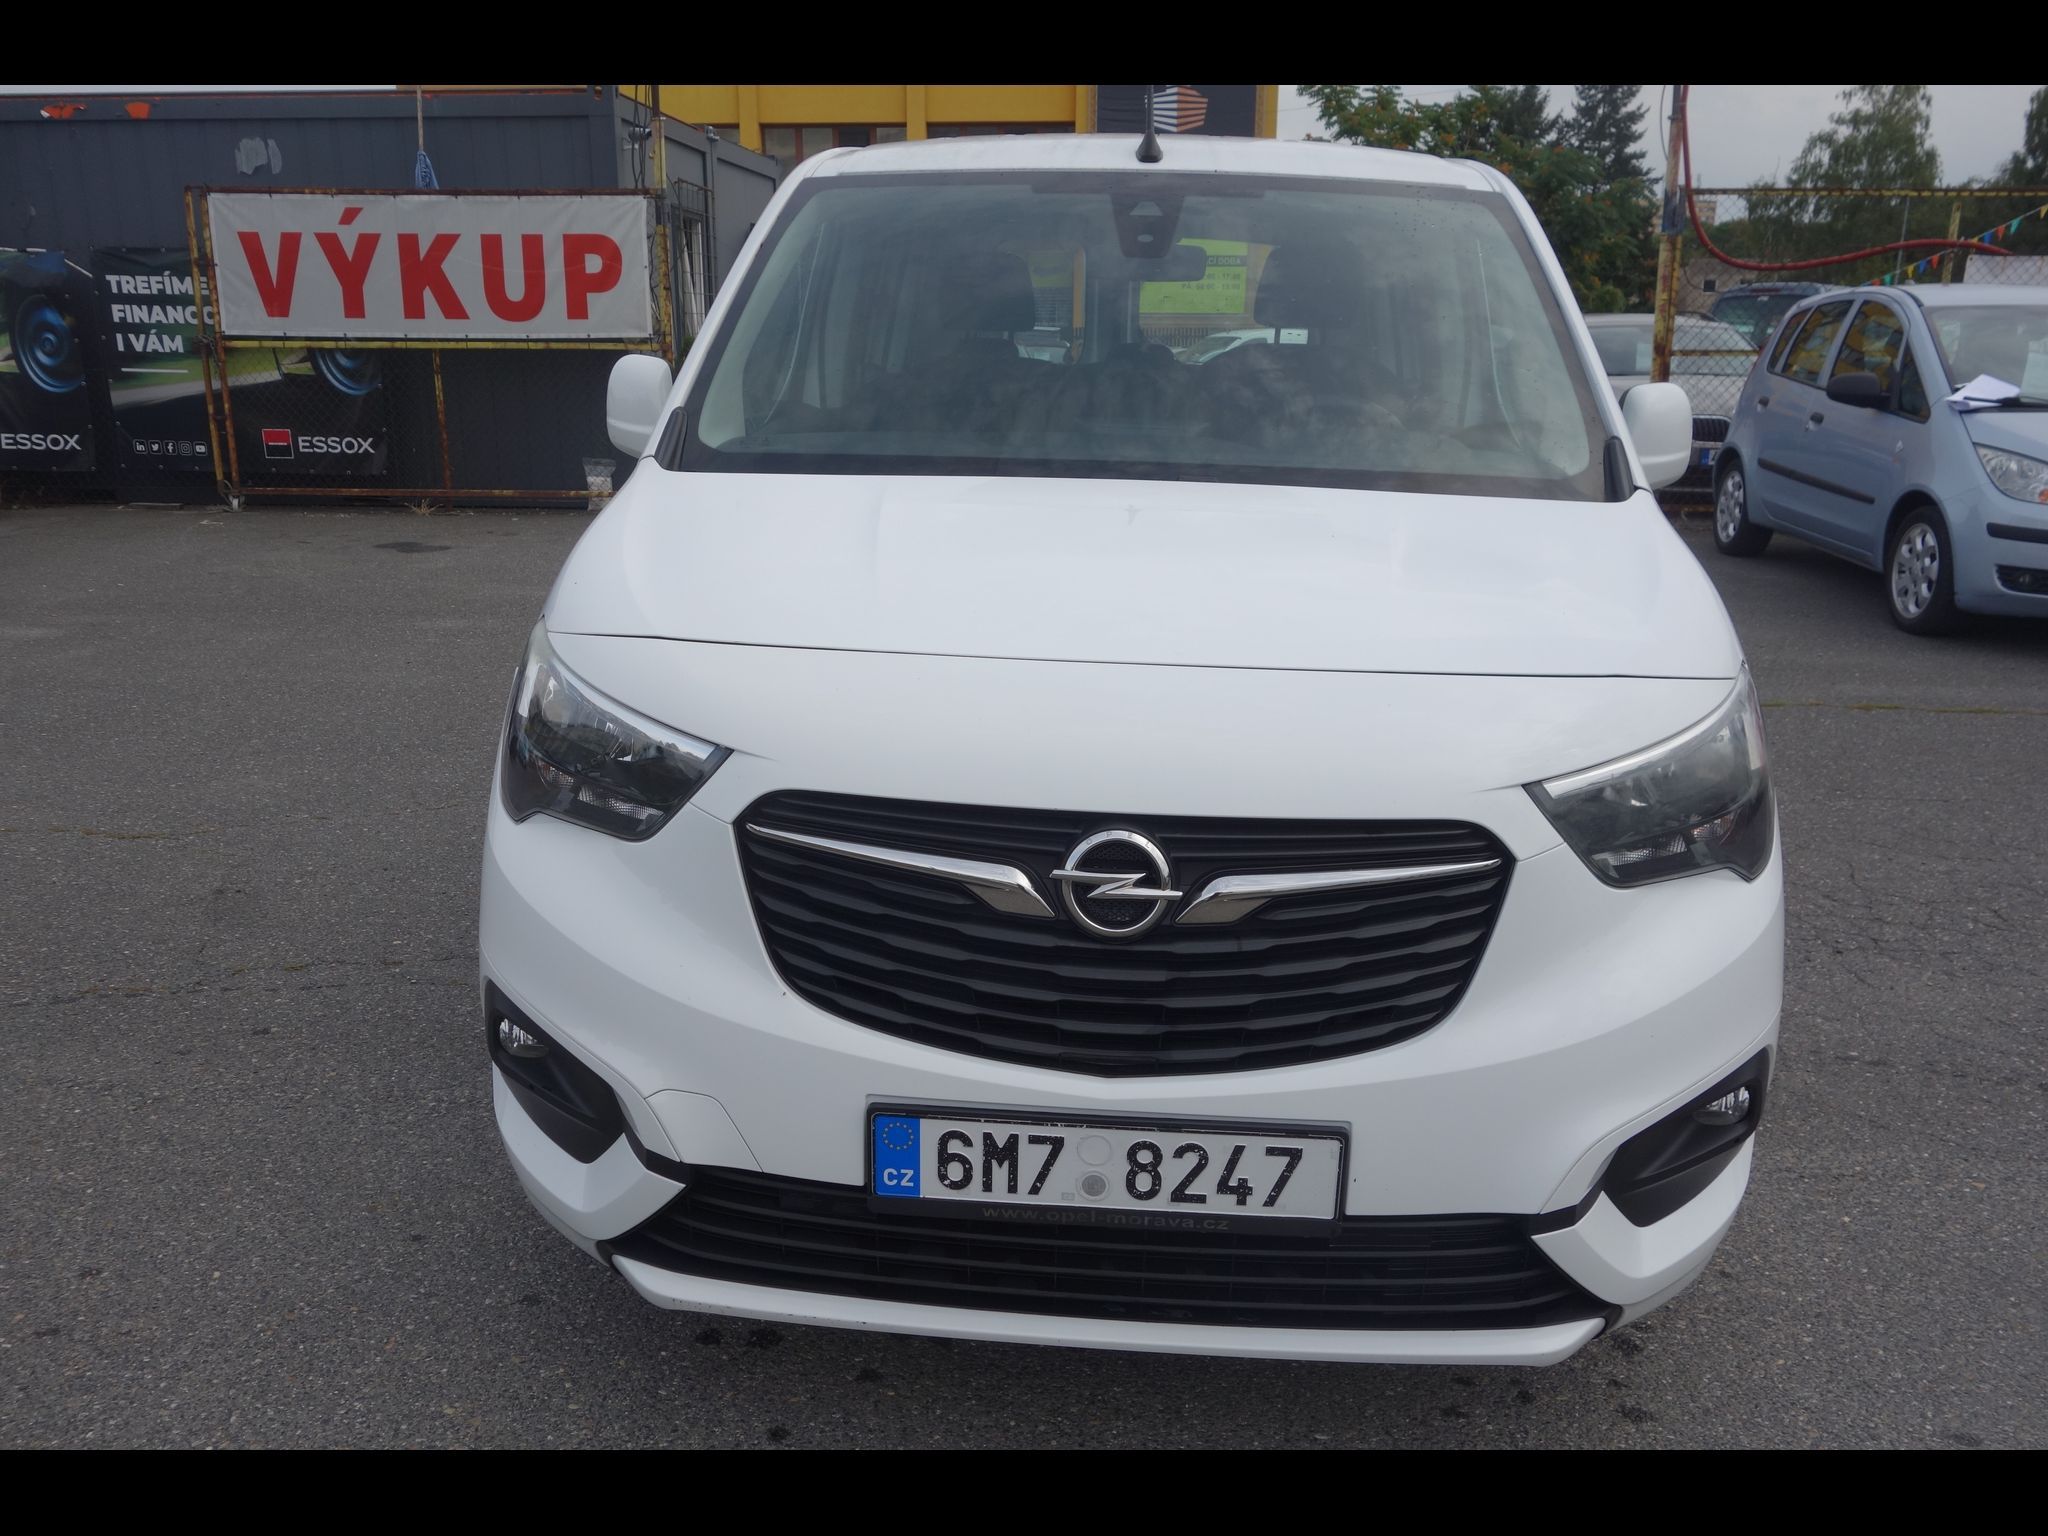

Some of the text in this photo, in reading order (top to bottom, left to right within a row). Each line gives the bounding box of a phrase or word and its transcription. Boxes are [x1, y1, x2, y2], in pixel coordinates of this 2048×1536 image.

[237, 207, 622, 322] VÝKUP
[105, 270, 210, 295] TREFÍME
[115, 329, 185, 353] I VÁM
[0, 433, 81, 450] ESSOX
[298, 436, 376, 454] ESSOX
[883, 1168, 914, 1187] CZ
[937, 1129, 1303, 1207] 6M7 8247
